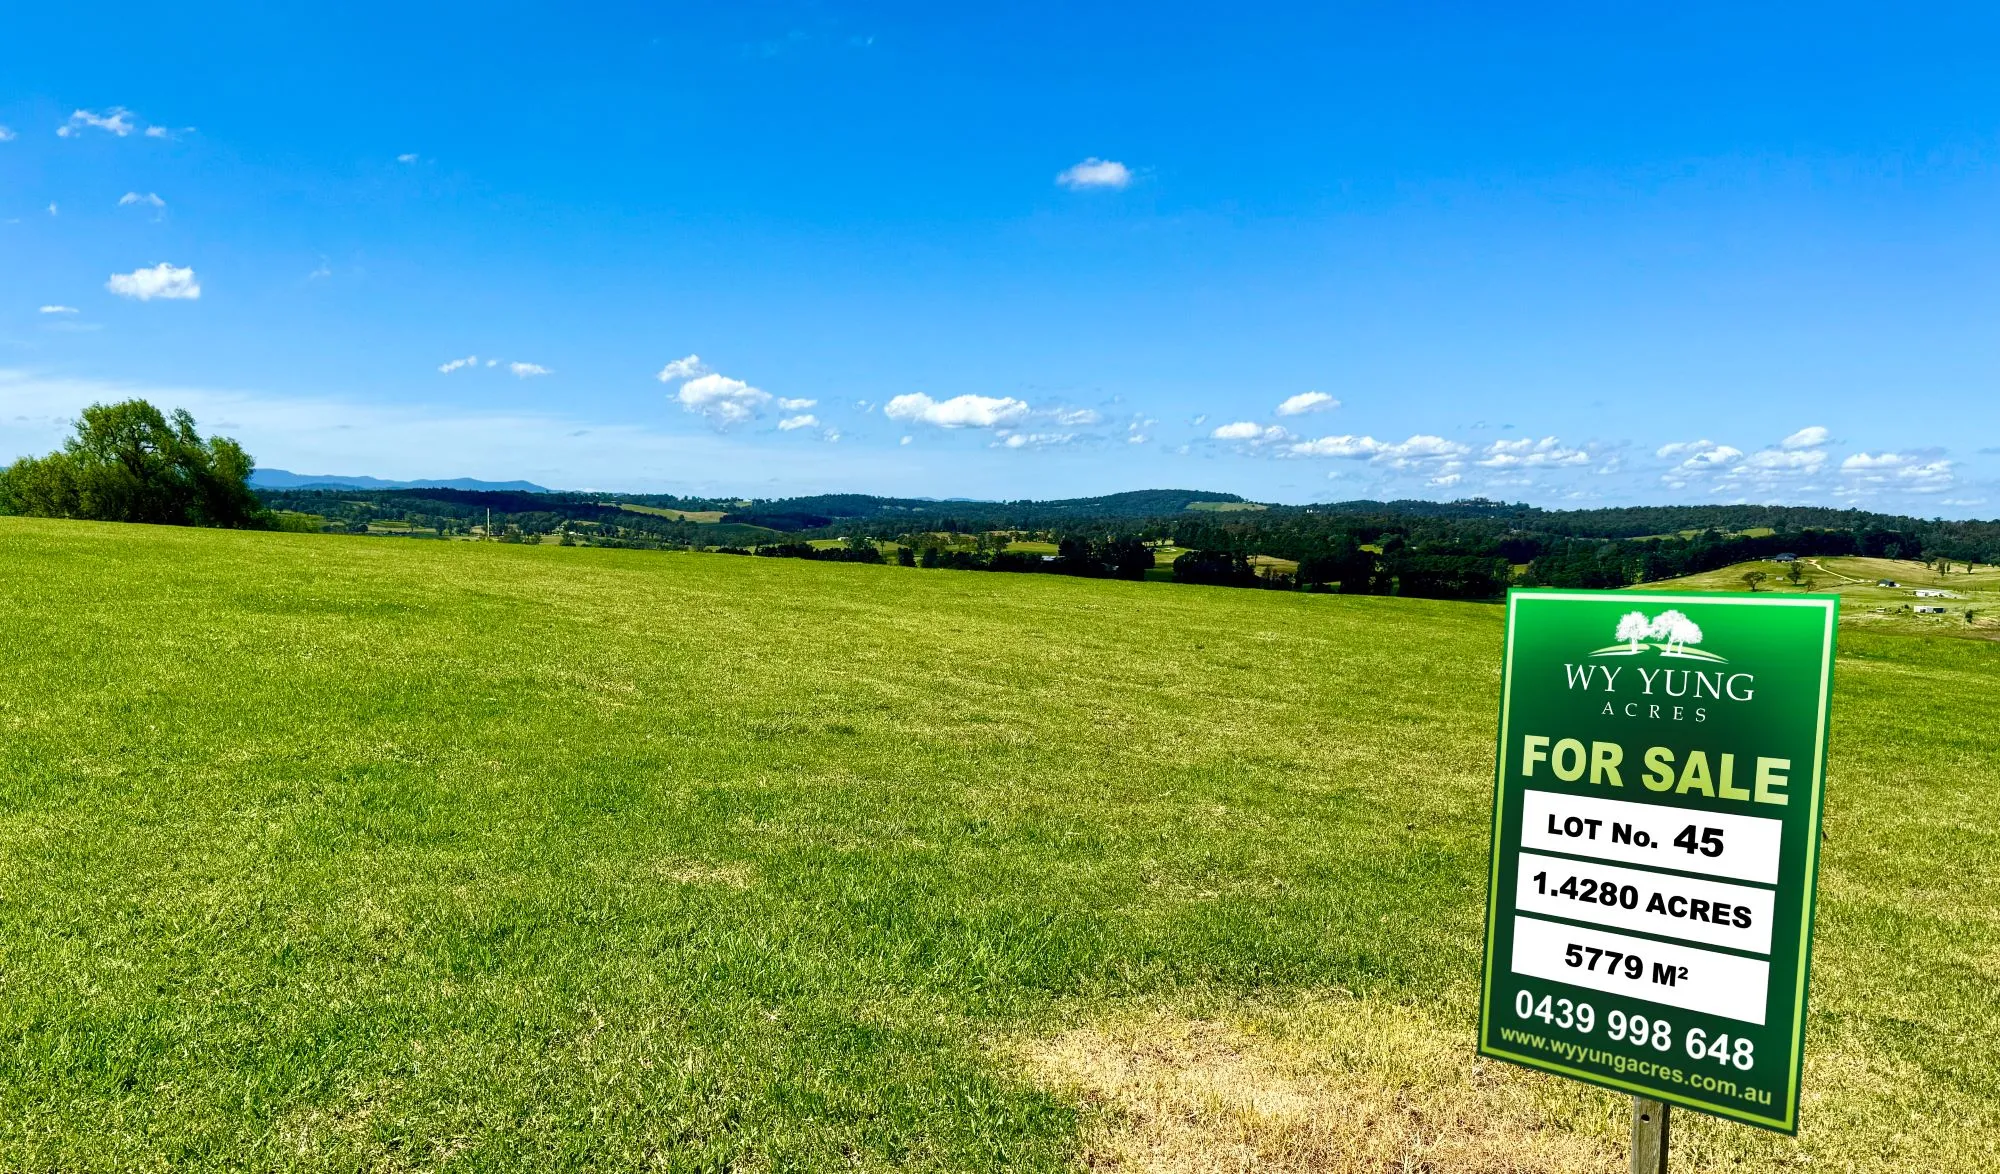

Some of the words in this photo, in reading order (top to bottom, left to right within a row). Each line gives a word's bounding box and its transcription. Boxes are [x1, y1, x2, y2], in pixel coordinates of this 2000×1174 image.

[1564, 664, 1622, 692] WY
[1637, 667, 1755, 701] YUNG
[1601, 701, 1706, 723] ACRES
[1522, 734, 1624, 788] FOR
[1641, 746, 1791, 806] SALE
[1547, 813, 1603, 841] LOT
[1612, 822, 1658, 849] No.
[1673, 824, 1725, 858] 45
[1532, 871, 1639, 910] 1.4280
[1646, 892, 1752, 929] ACRES
[1564, 943, 1644, 981] 5779
[1515, 989, 1595, 1034] 0439
[1607, 1010, 1672, 1052] 998
[1685, 1027, 1755, 1071] 648
[1501, 1025, 1772, 1106] www.wyyungacres.com.au
